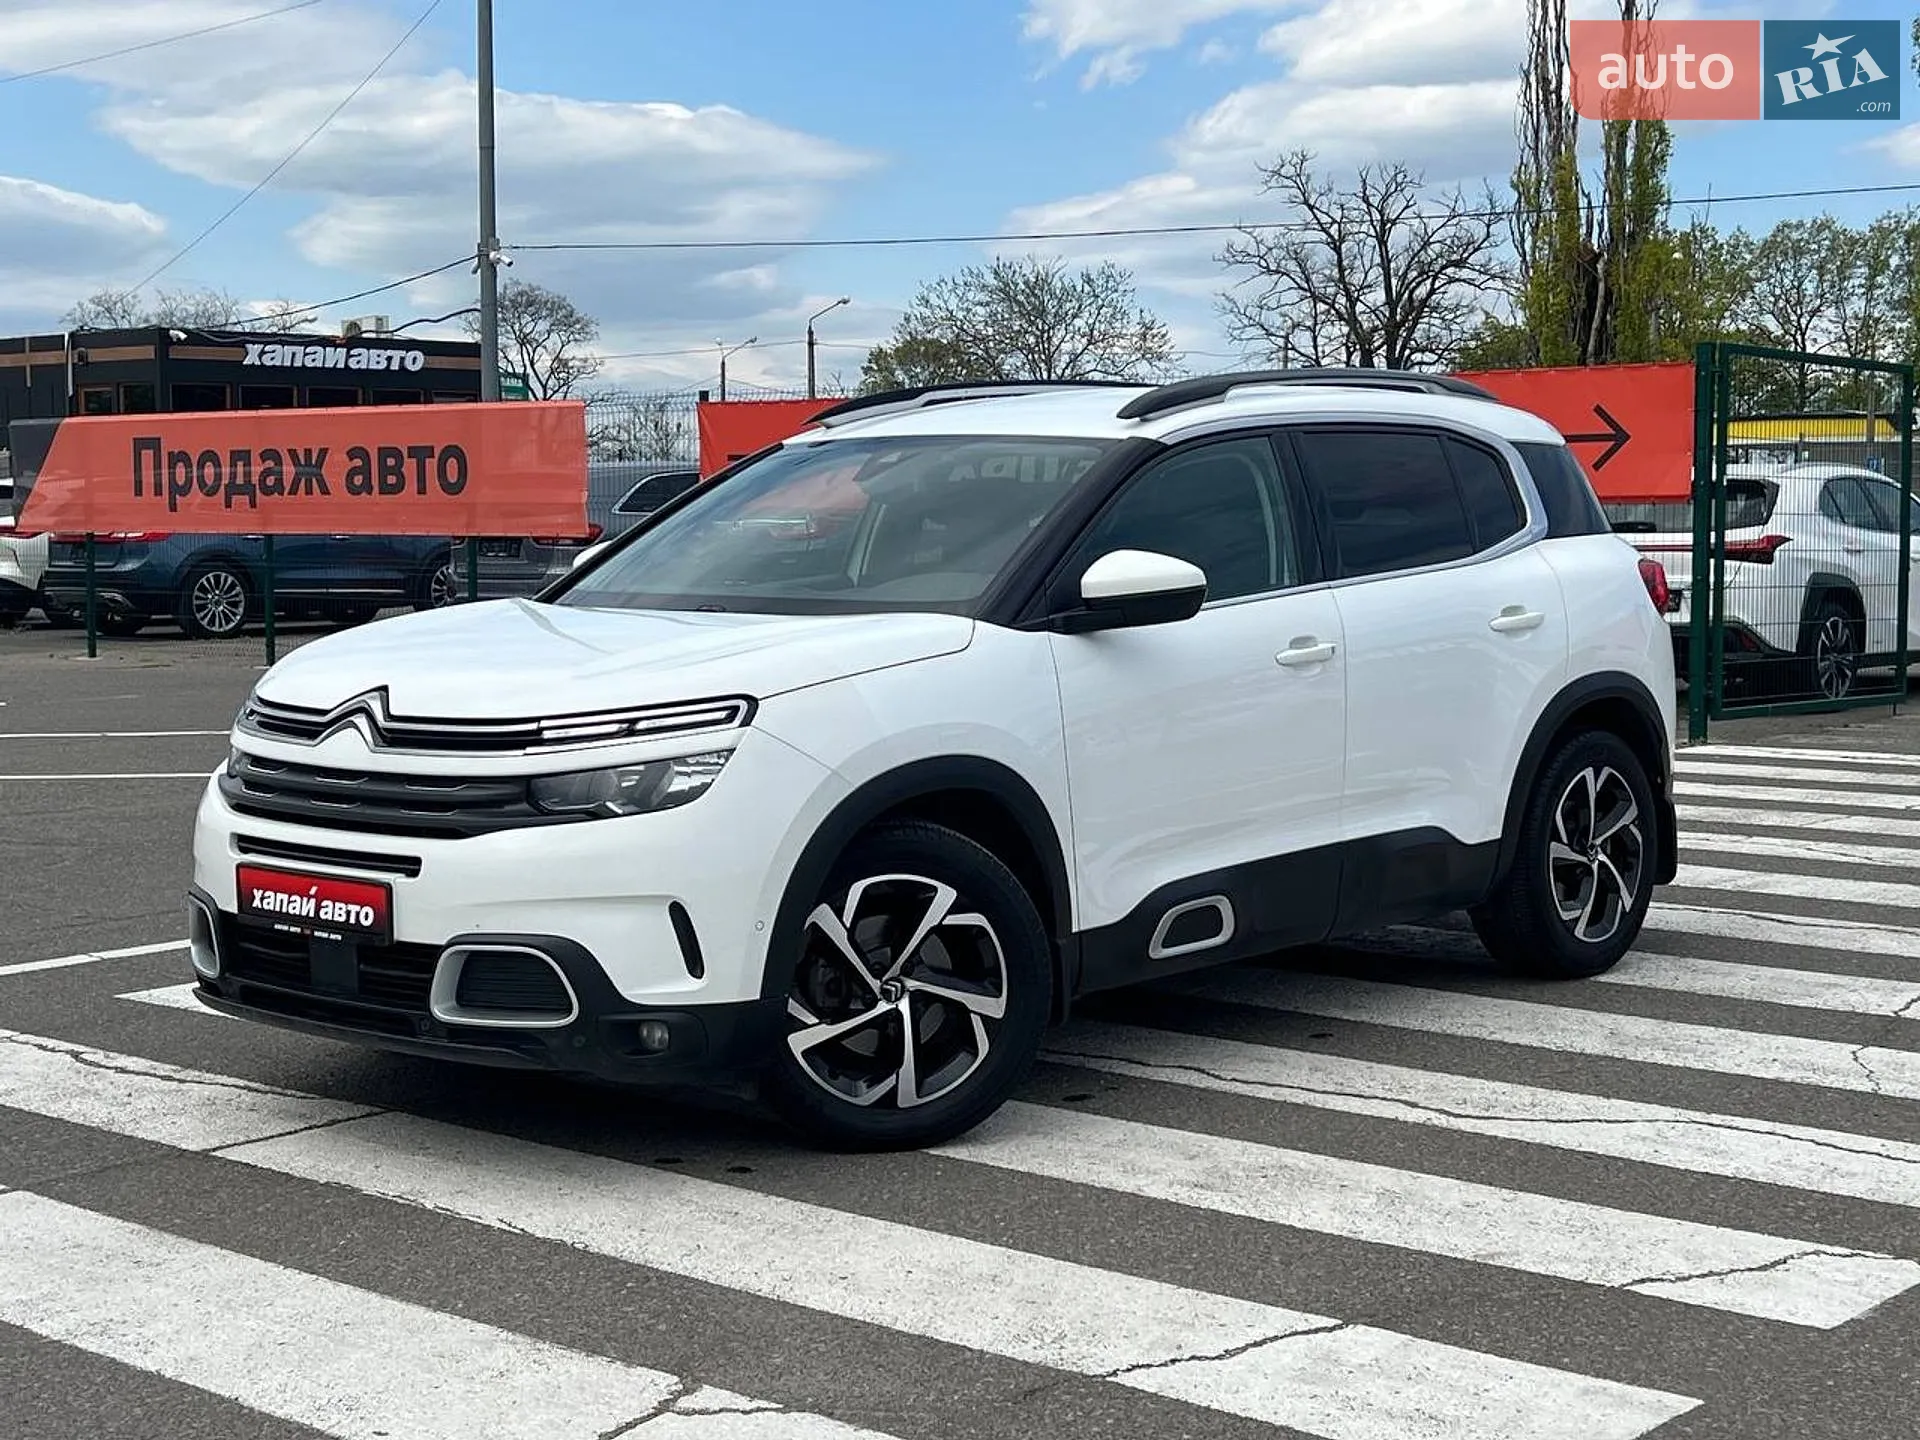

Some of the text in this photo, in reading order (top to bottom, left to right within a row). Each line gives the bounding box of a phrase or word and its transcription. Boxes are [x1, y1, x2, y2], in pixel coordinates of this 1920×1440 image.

[347, 348, 425, 372] авто
[132, 437, 468, 512] Продаж авто
[319, 900, 375, 927] авто
